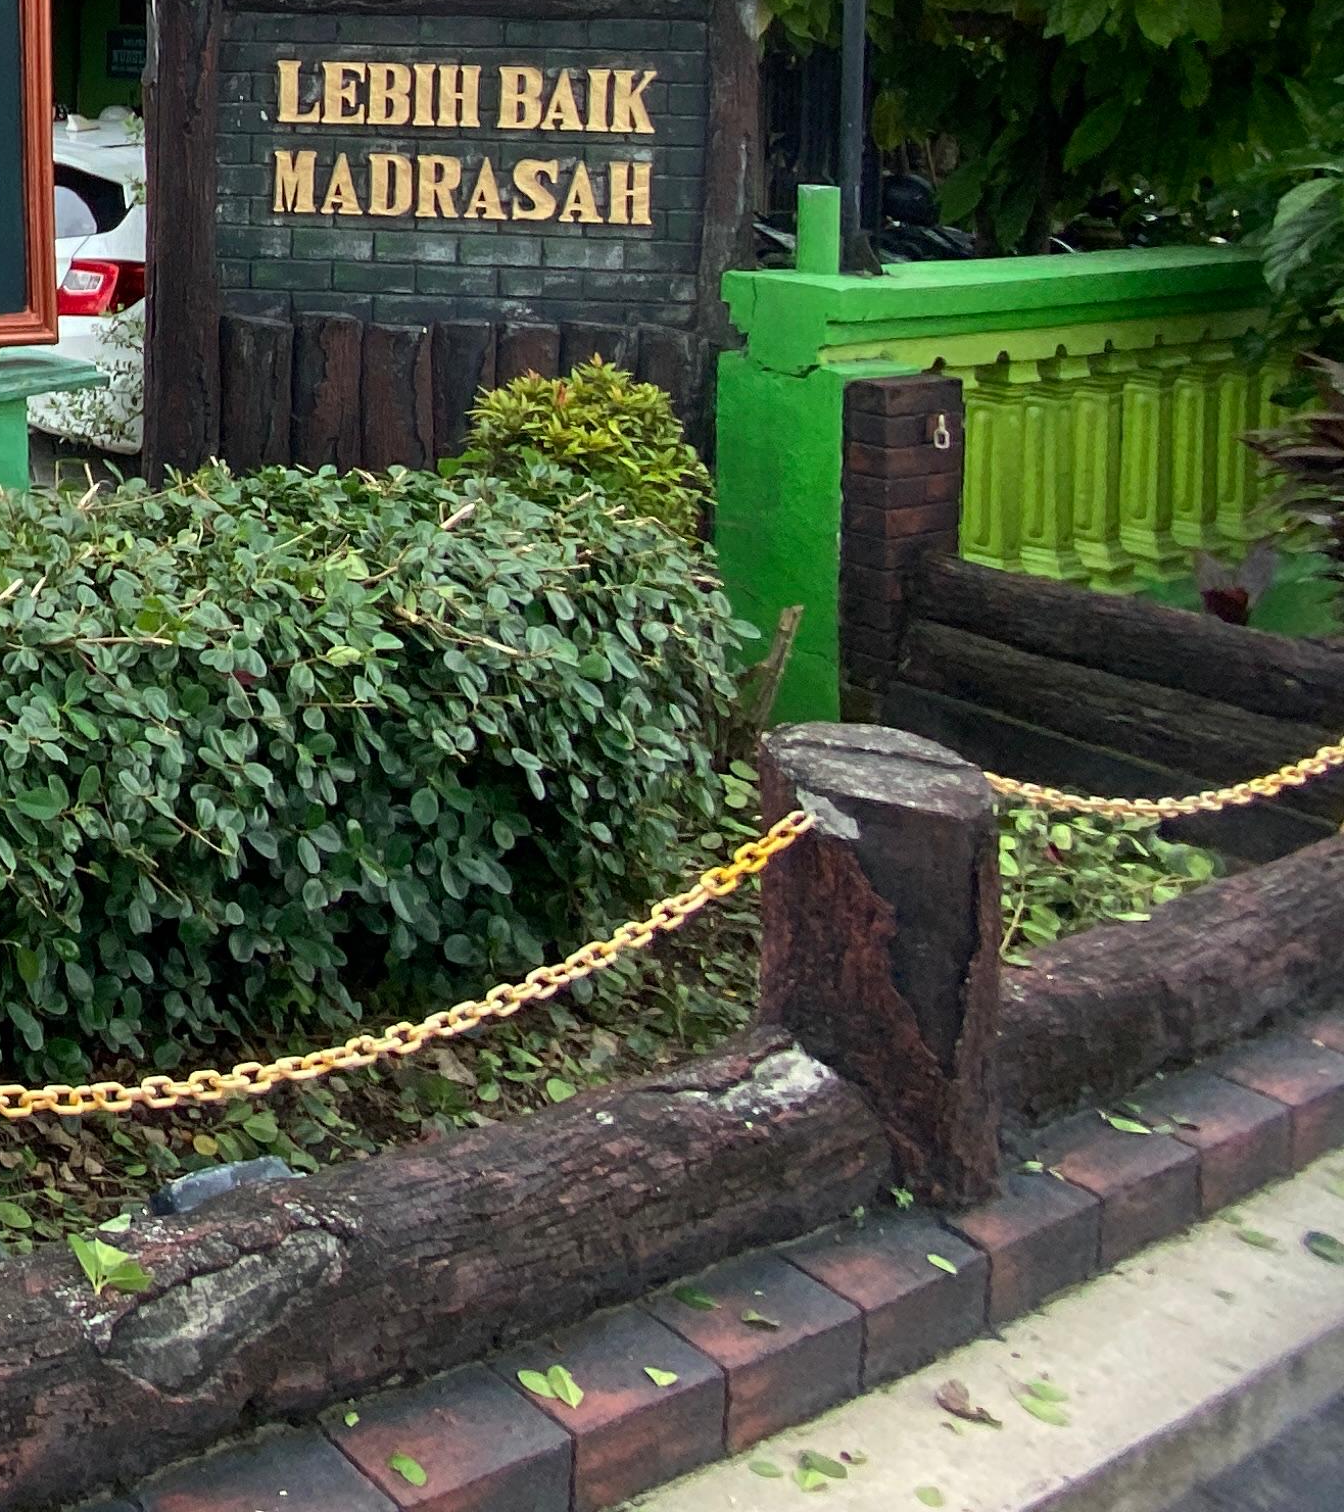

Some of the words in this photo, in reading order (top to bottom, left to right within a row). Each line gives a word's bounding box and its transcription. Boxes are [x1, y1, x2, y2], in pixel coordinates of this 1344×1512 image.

[276, 58, 482, 128] LEBIH
[496, 65, 658, 135] BAIK
[272, 150, 654, 226] MADRASAH
